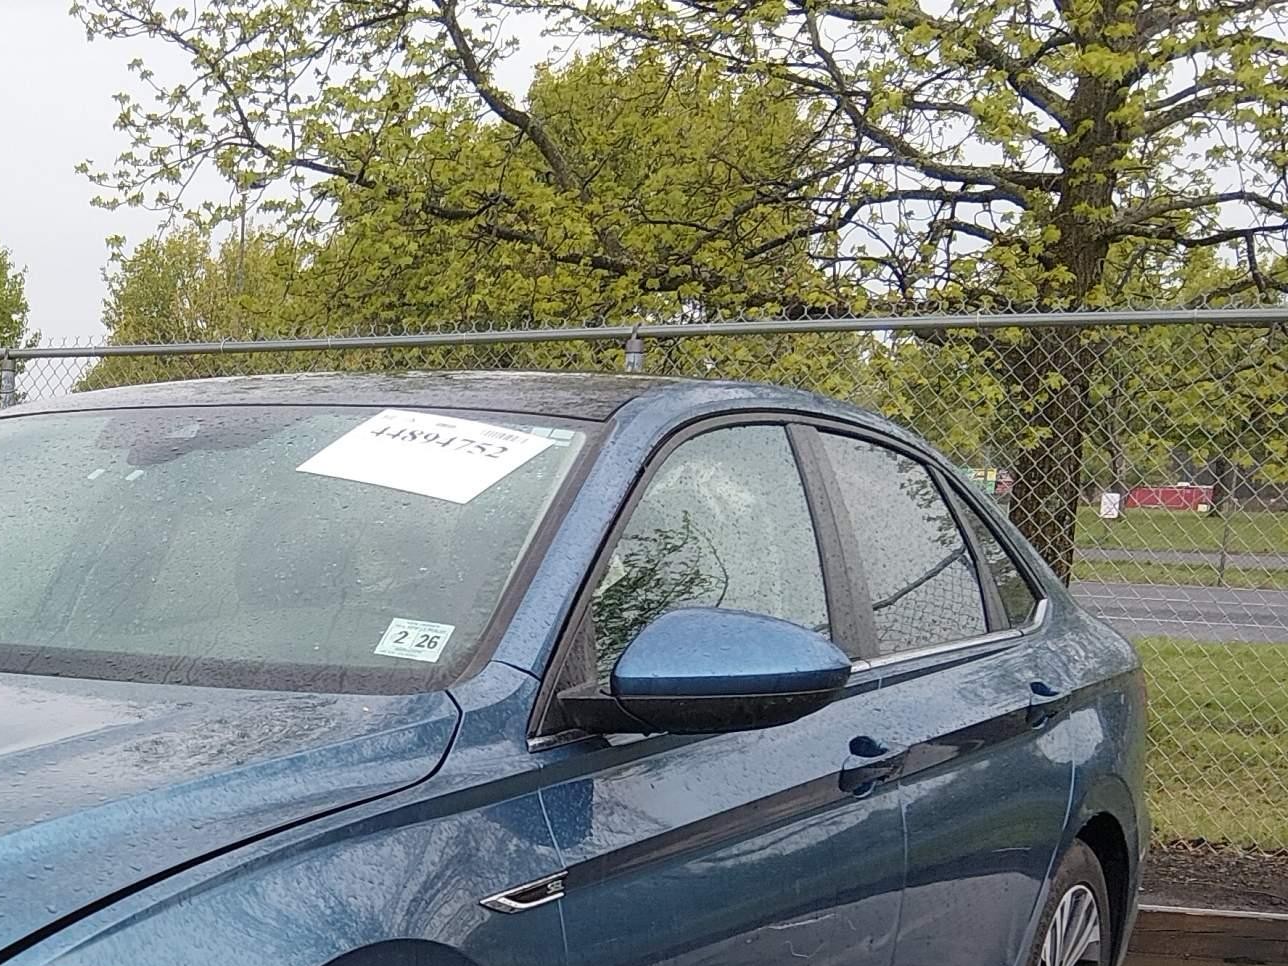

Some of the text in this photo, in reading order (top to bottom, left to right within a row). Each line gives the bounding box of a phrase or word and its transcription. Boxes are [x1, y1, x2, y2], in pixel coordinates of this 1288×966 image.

[370, 426, 509, 459] 44894752
[393, 630, 441, 650] 2 26
